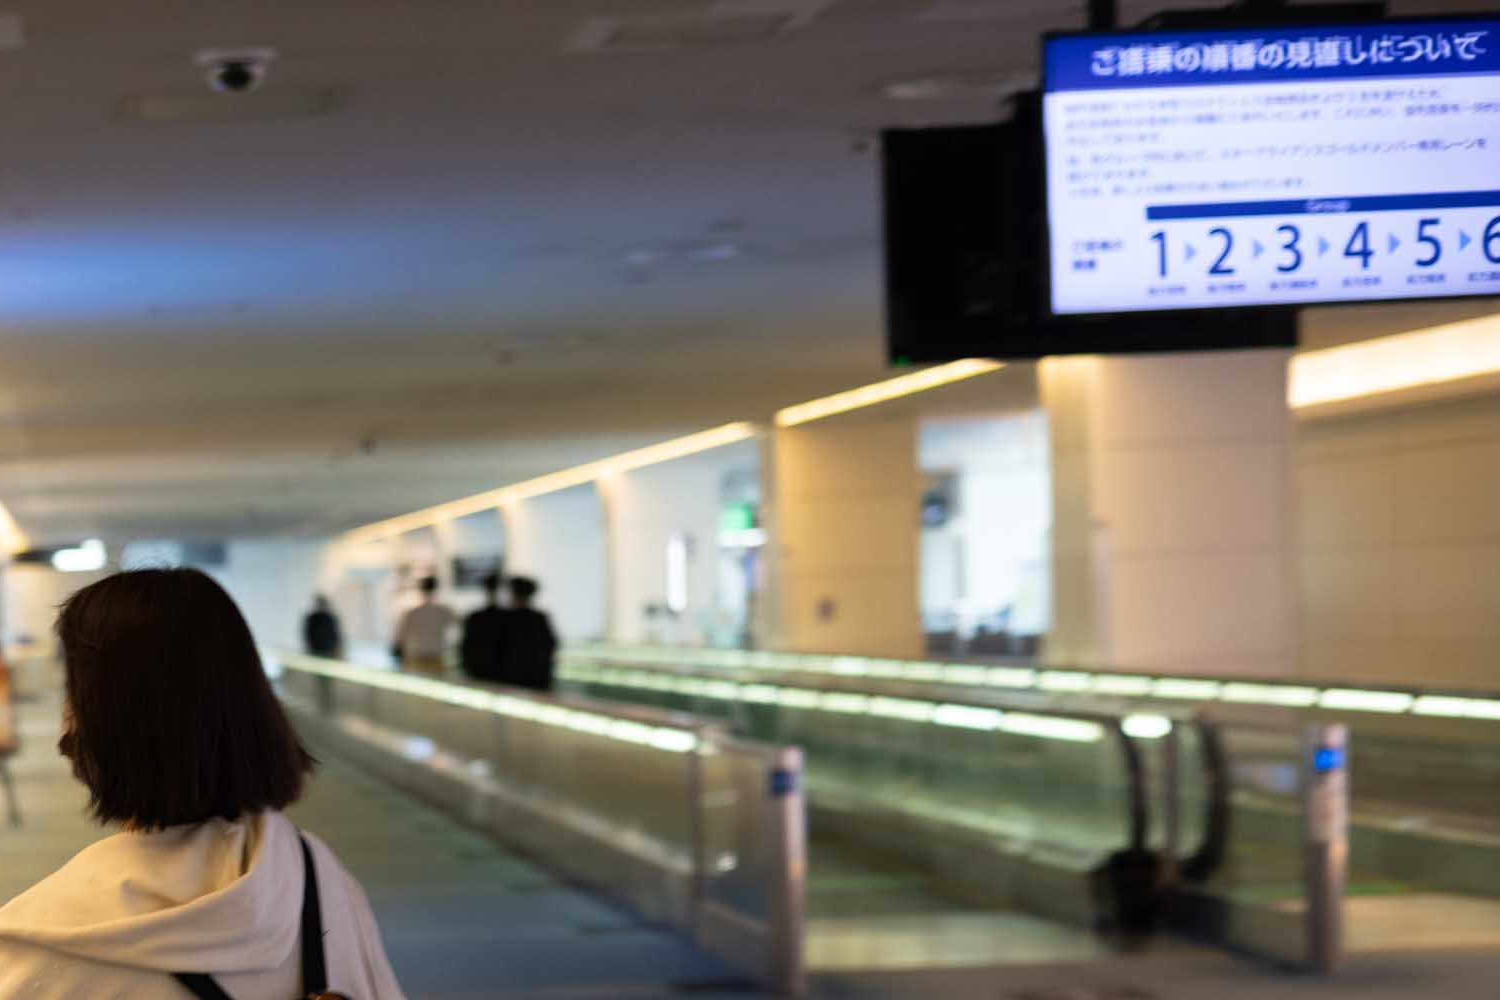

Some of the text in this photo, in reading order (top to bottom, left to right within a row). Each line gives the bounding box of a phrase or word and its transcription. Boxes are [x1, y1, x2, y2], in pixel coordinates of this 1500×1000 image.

[1150, 231, 1168, 278] 1
[1208, 227, 1235, 275] 2
[1276, 225, 1303, 272] 3
[1343, 221, 1374, 269] 4
[1415, 218, 1442, 267] 5
